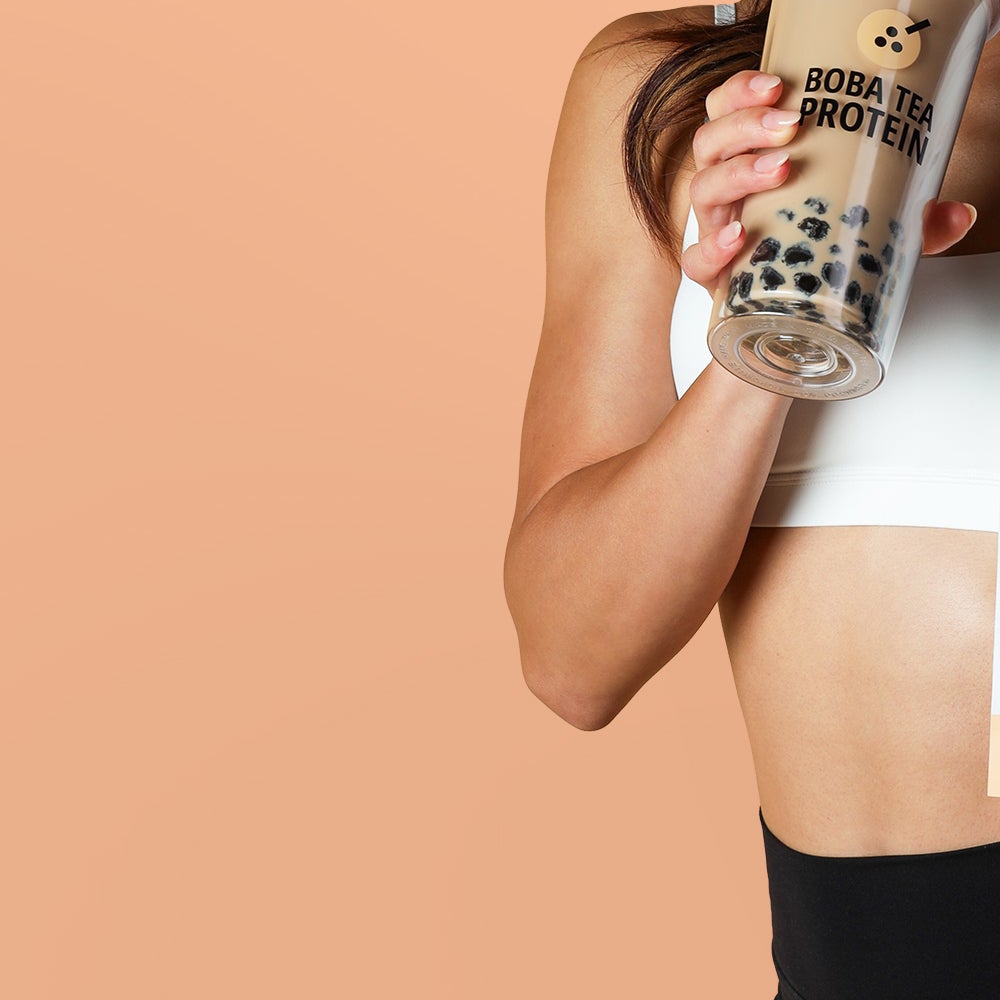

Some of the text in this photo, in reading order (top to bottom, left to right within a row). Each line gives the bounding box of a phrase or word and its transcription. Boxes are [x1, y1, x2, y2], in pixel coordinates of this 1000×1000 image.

[799, 97, 929, 166] PROTEIN
[804, 67, 934, 133] BOBA TEA
